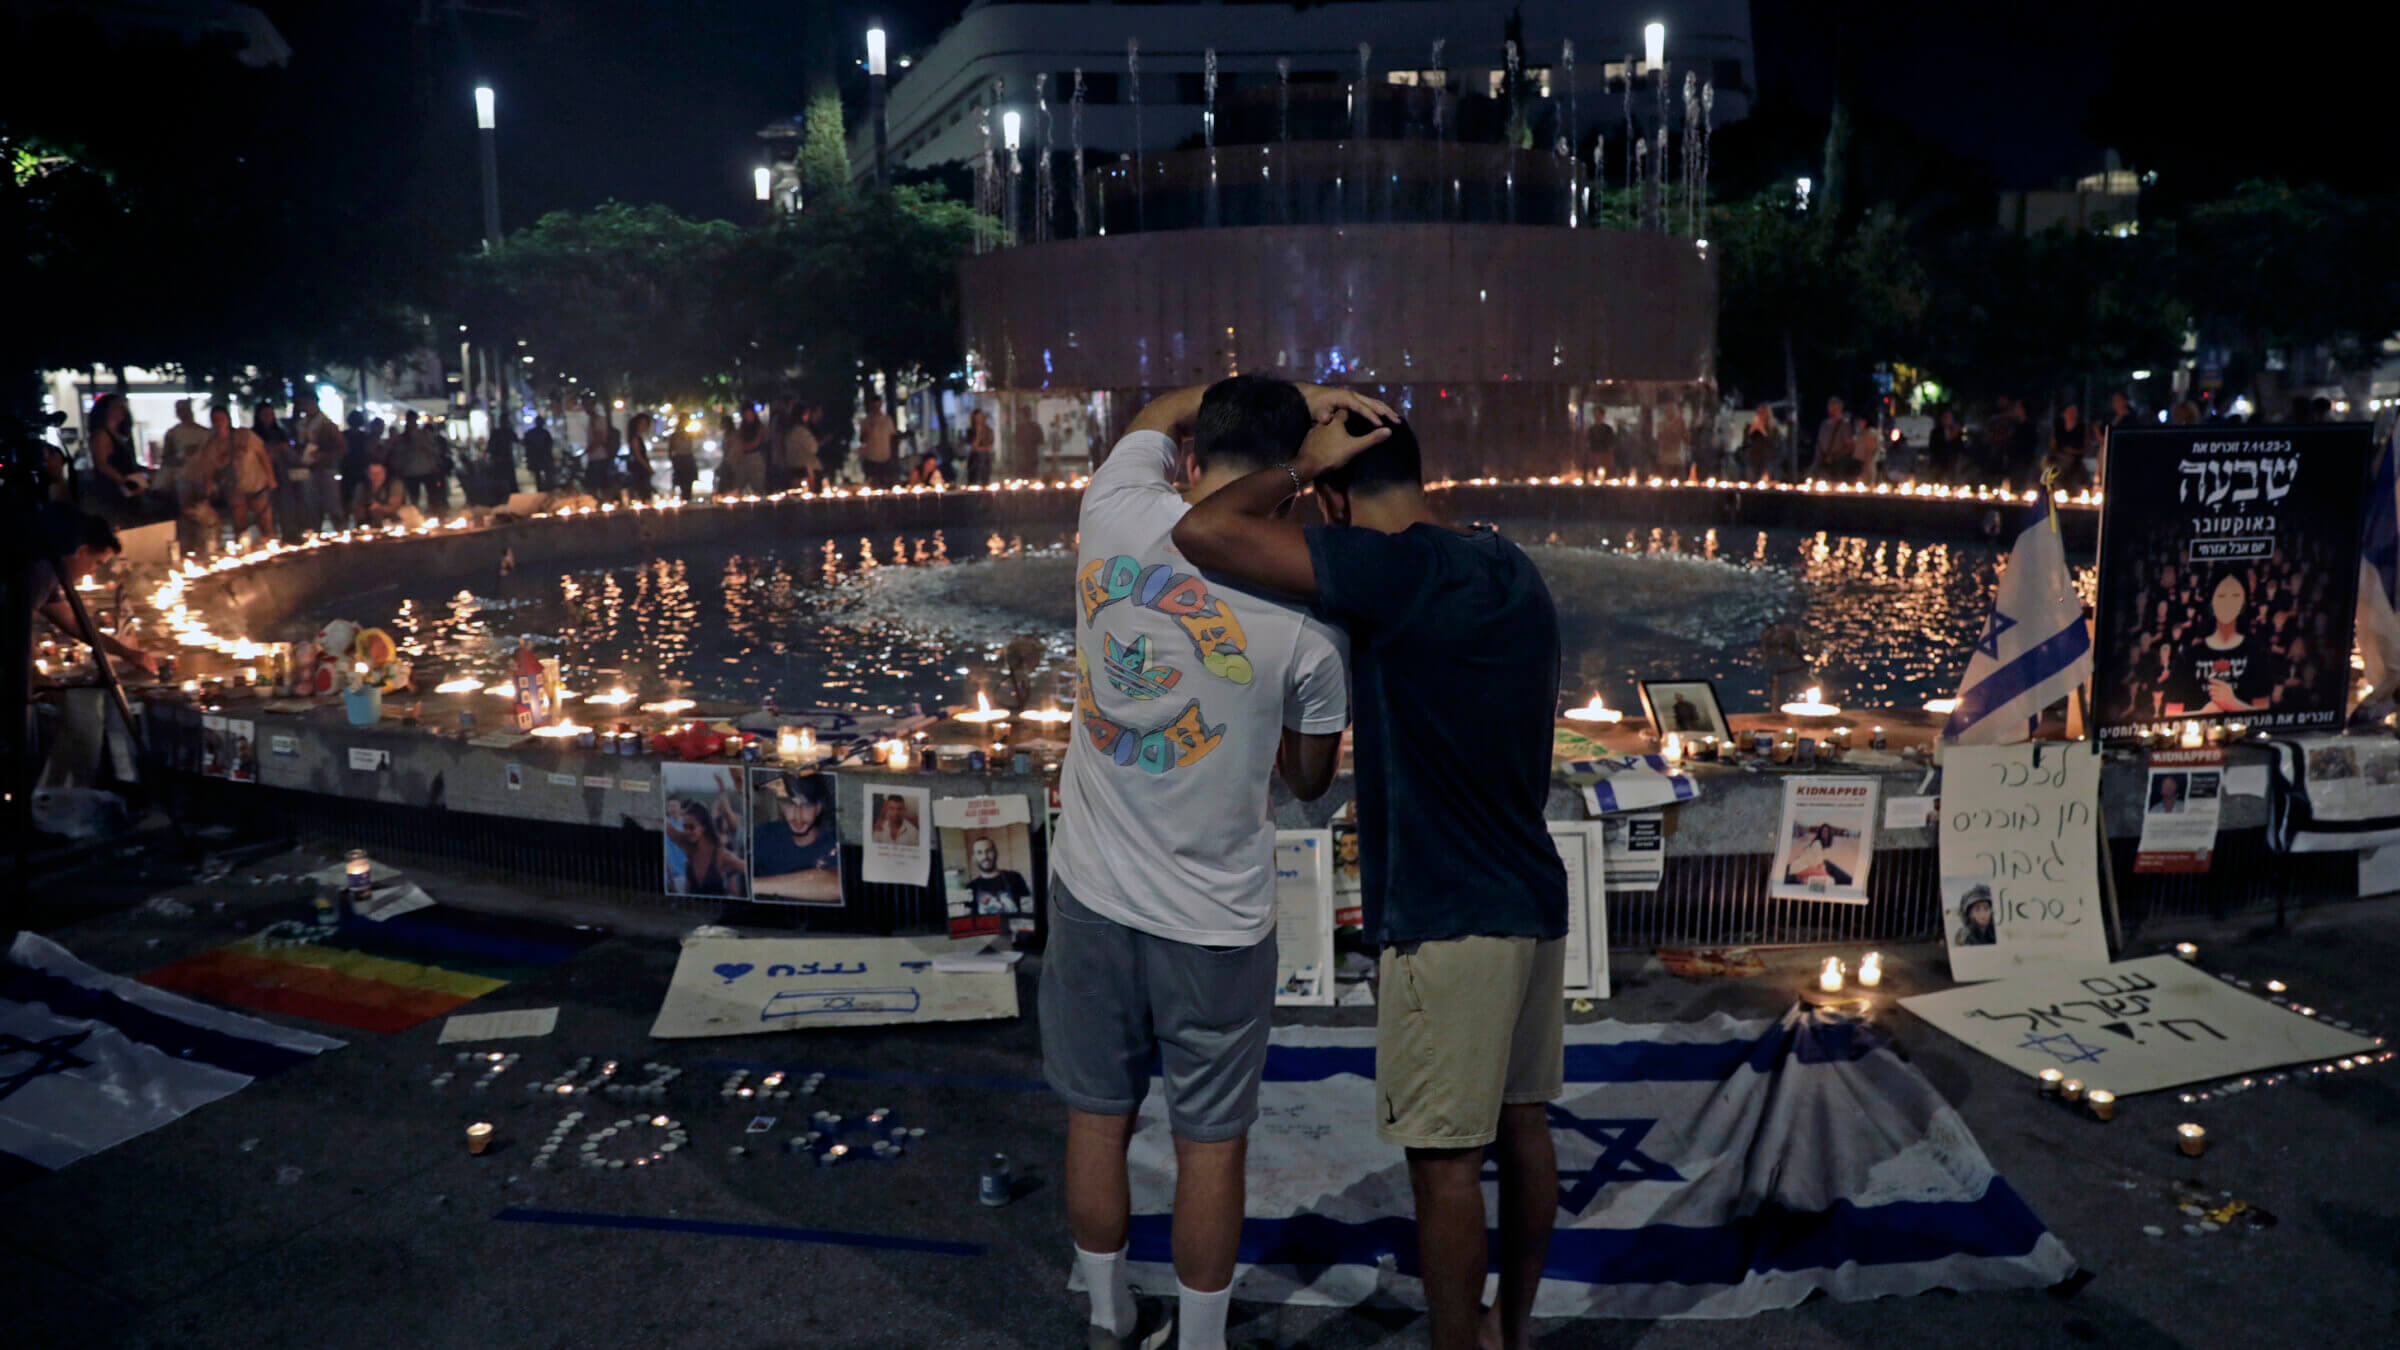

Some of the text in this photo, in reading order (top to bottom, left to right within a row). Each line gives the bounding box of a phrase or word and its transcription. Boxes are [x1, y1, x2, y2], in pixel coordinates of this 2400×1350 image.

[2192, 442, 2208, 454] את
[2192, 516, 2276, 536] באוקטובר
[2228, 541, 2249, 554] אבל
[2251, 542, 2266, 553] יום
[2152, 750, 2222, 762] KIDNAPPED
[1796, 786, 1867, 796] KIDNAPPED
[2058, 801, 2089, 839] חן
[1976, 840, 2065, 882] גיבור
[1998, 887, 2083, 926] ישראל
[2080, 973, 2158, 996] עם
[1964, 995, 2151, 1032] ישראל
